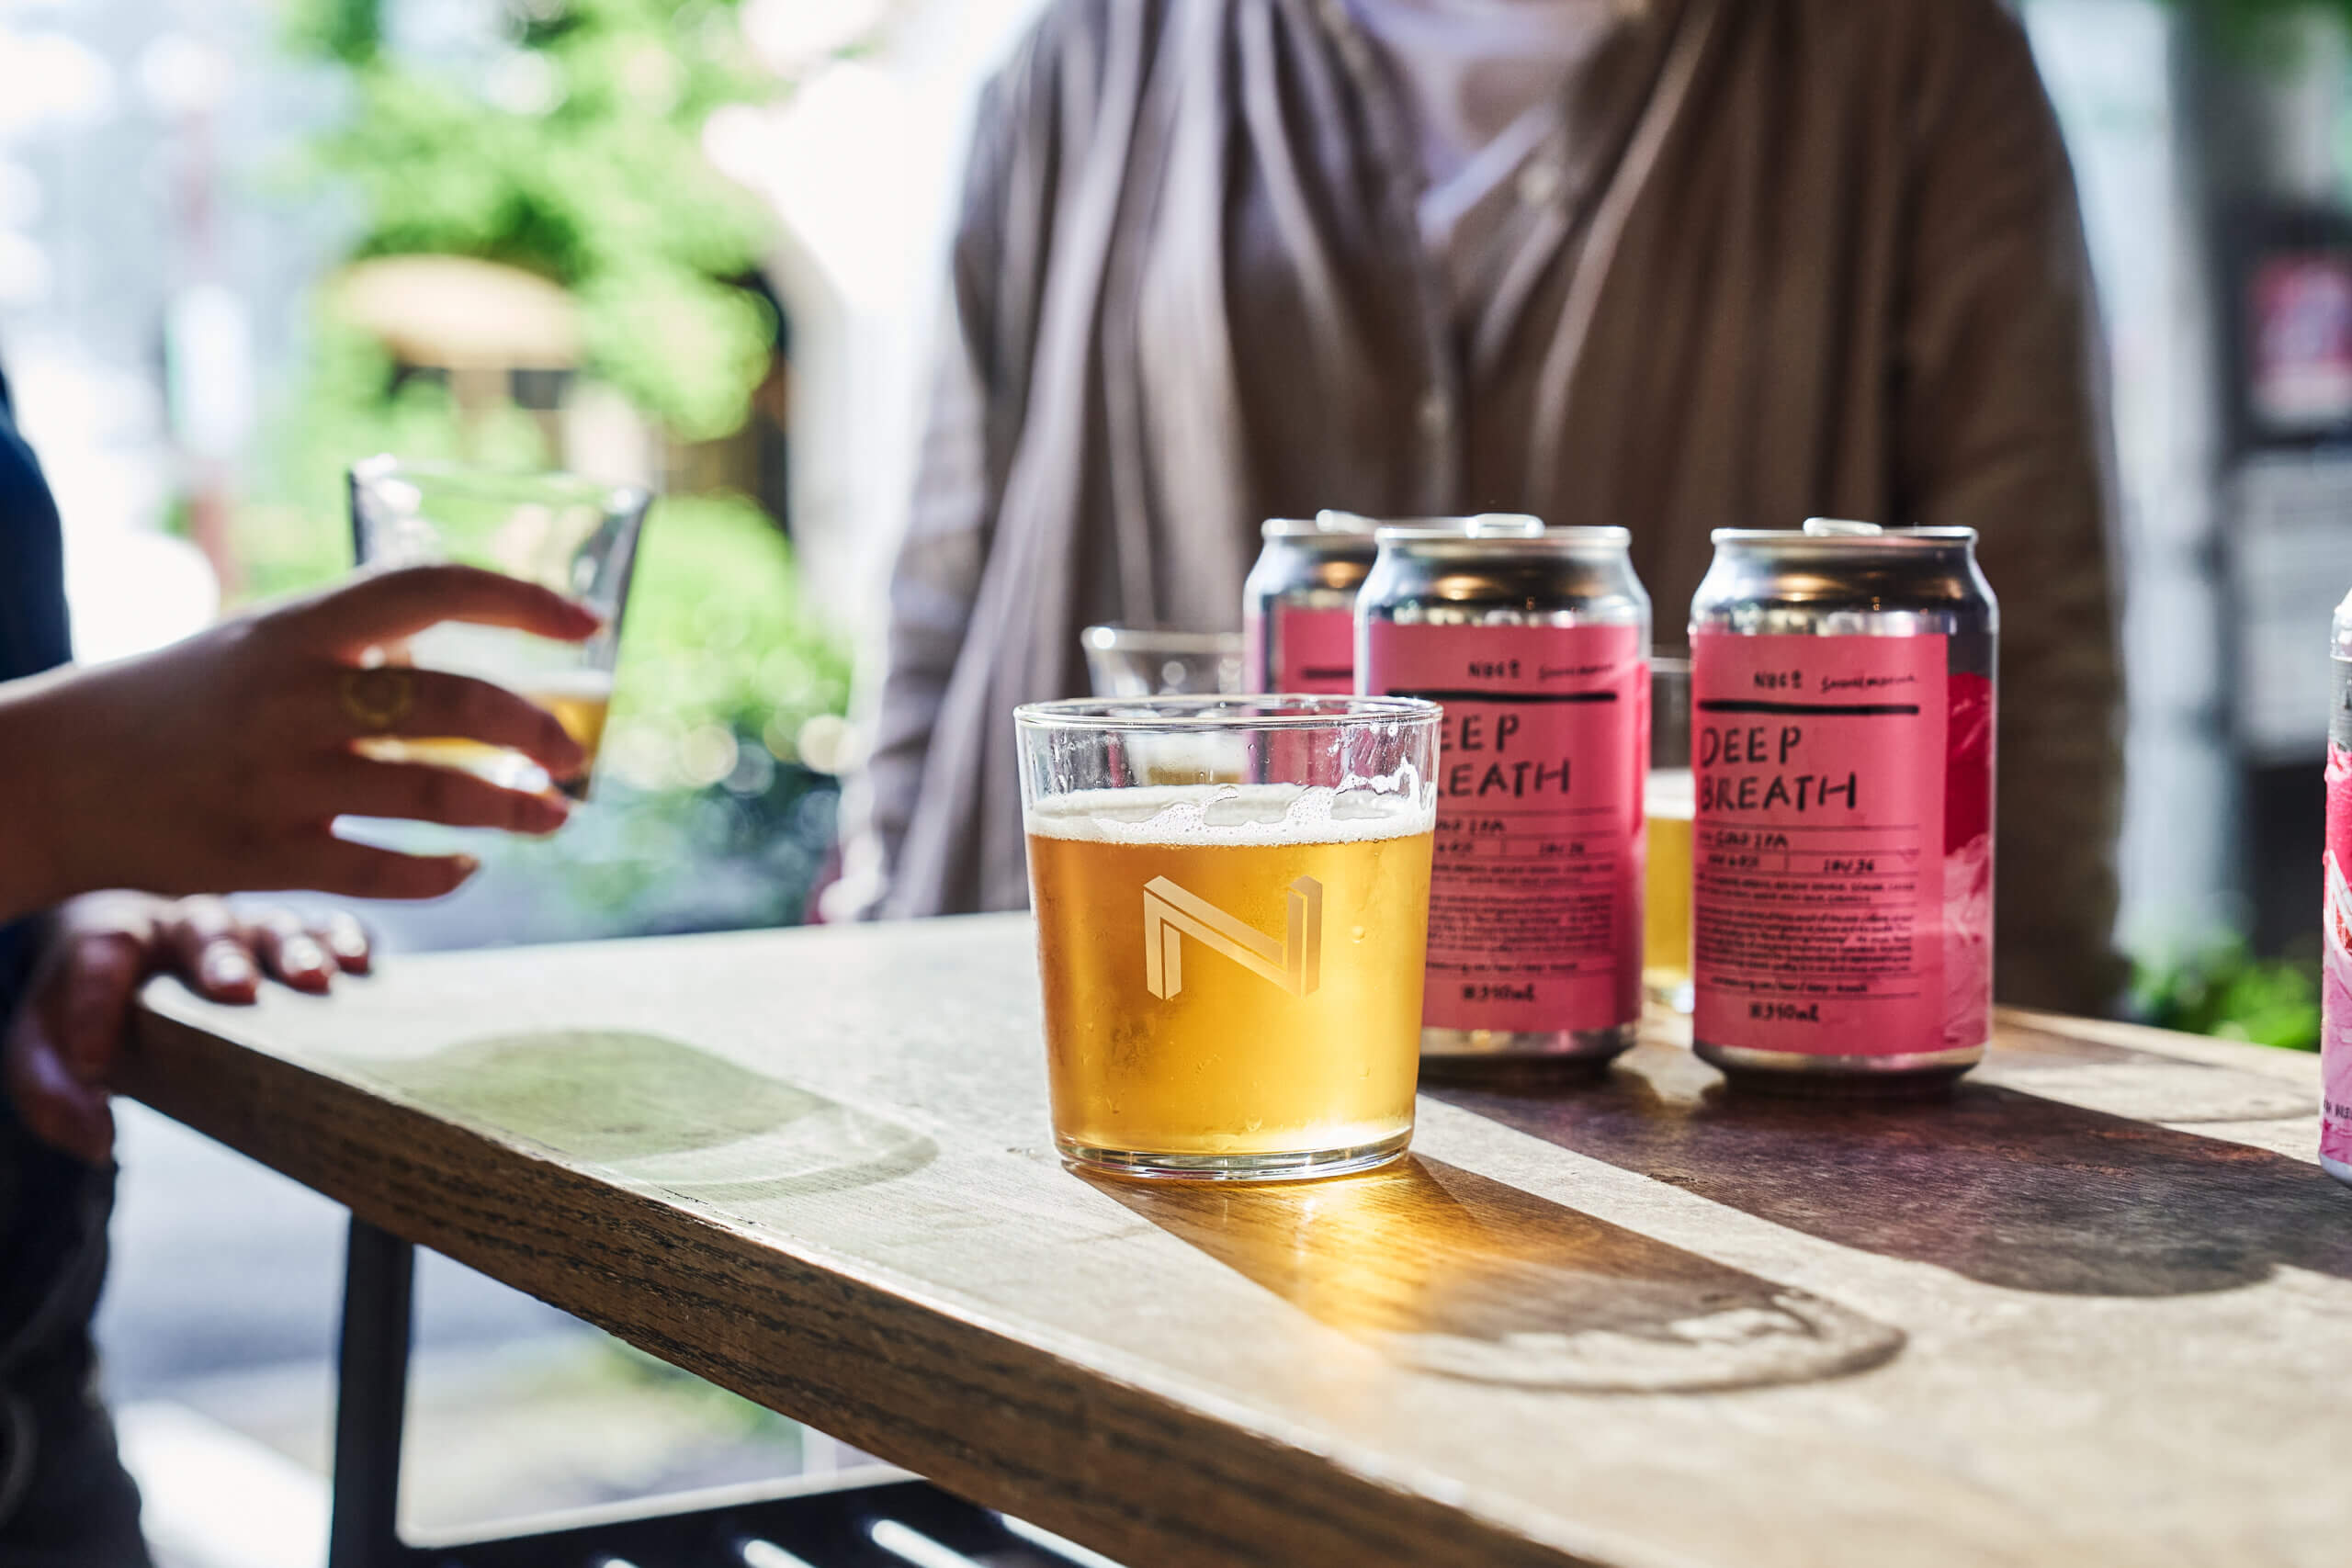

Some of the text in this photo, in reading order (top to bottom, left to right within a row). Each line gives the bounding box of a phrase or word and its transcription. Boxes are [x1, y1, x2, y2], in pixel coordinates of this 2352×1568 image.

[1439, 714, 1521, 752] EEP
[1702, 726, 1803, 768] DEEP
[1438, 758, 1571, 799] EATH
[1702, 770, 1857, 812] BREATH
[1143, 874, 1323, 1000] N
